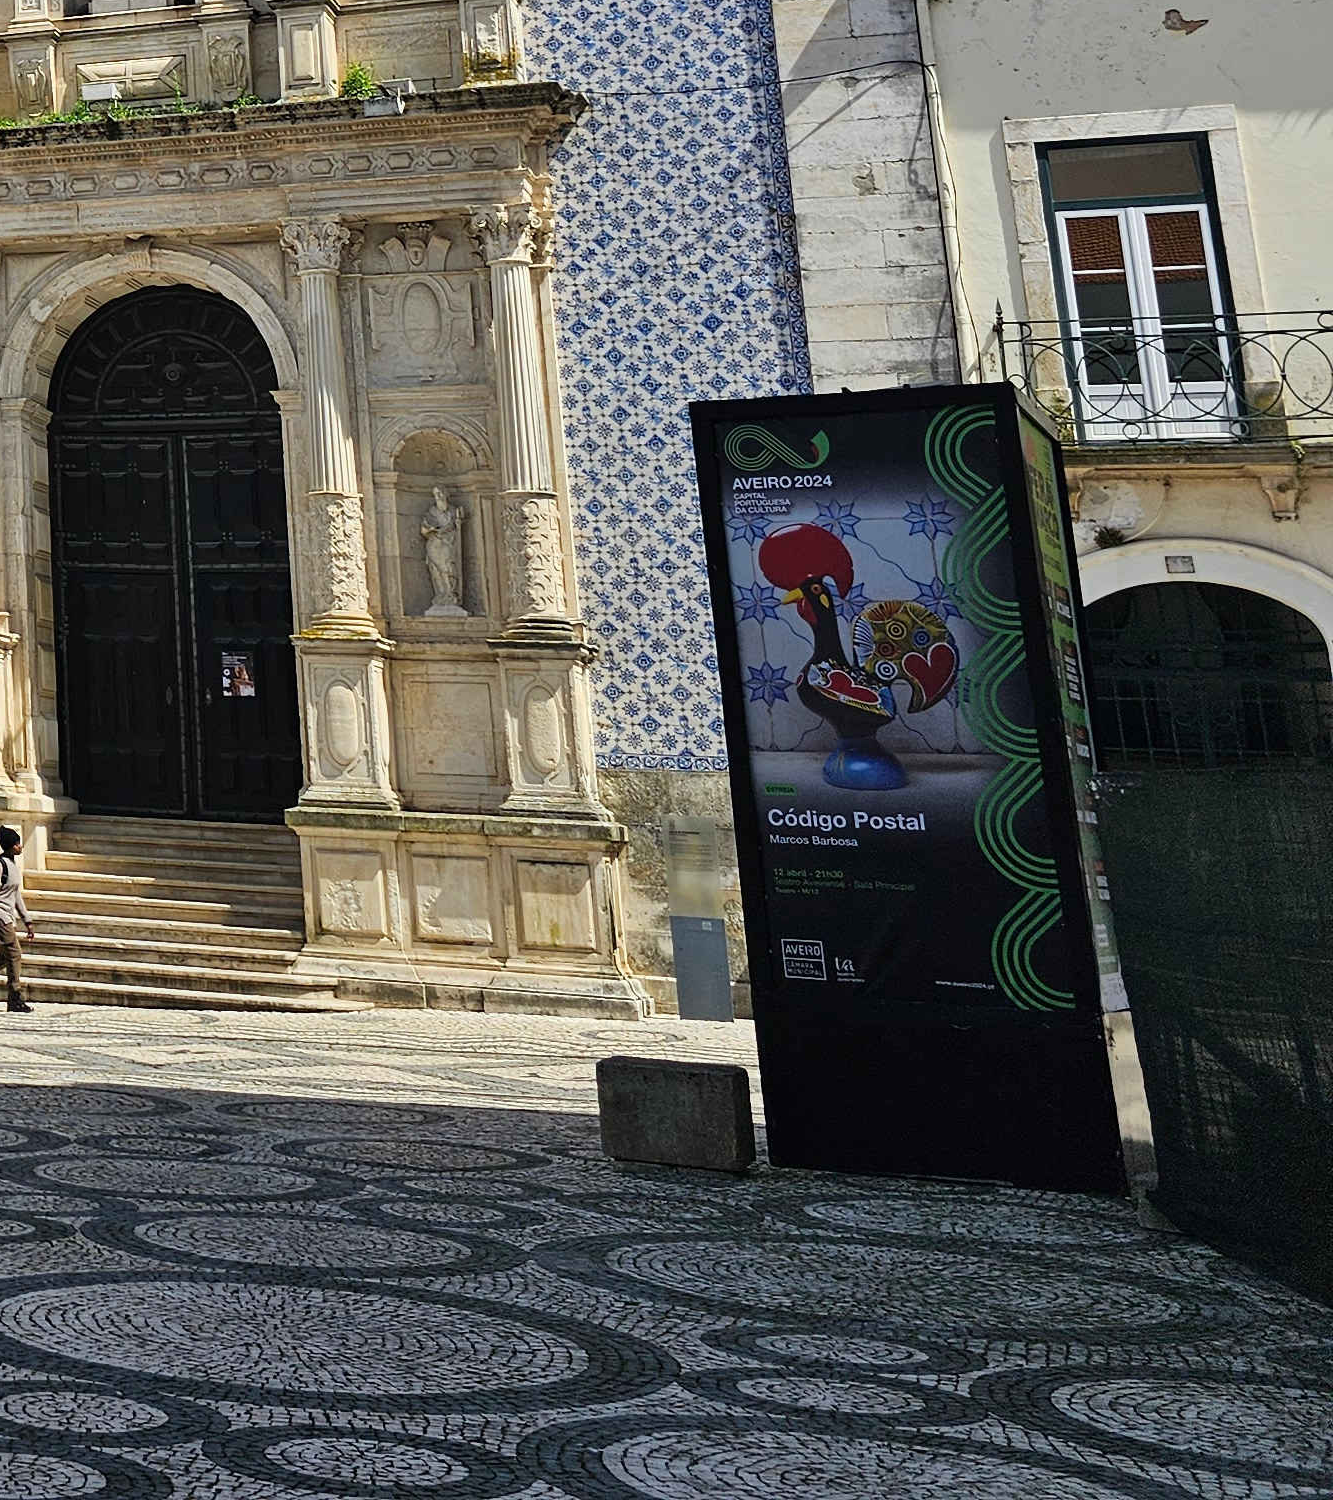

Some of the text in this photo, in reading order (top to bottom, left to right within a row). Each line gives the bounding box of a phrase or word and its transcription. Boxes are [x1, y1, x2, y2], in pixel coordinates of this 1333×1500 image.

[732, 474, 833, 490] AVEIRO 2024
[733, 492, 767, 500] CAPITAL
[734, 498, 791, 507] PORTUGUESA
[735, 506, 788, 514] DA CULTURA
[767, 807, 926, 832] Código Postal
[769, 834, 859, 847] Marcos Barbosa
[785, 944, 821, 957] AVEIRO
